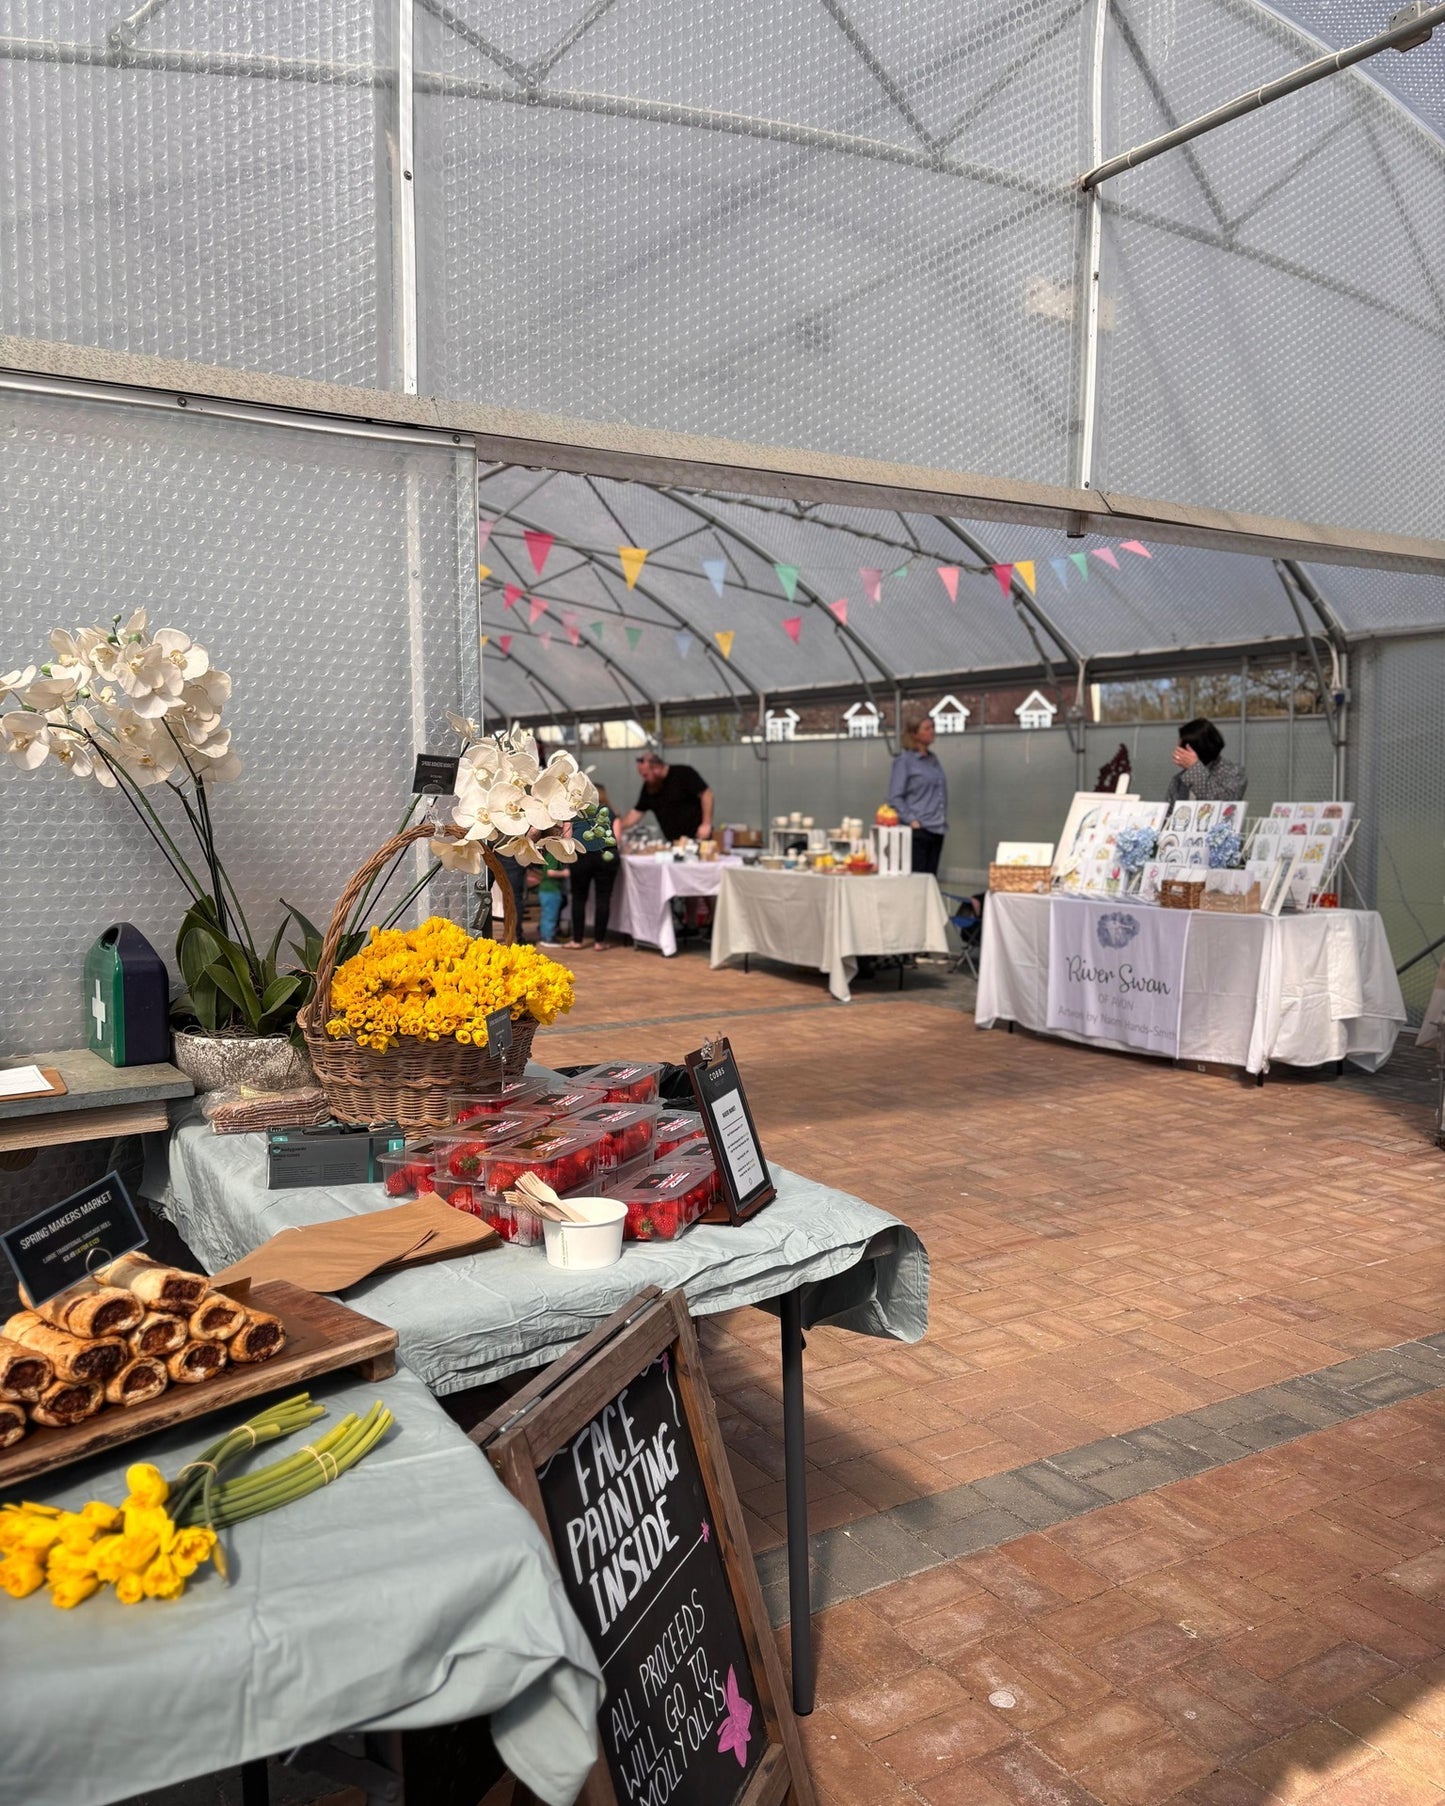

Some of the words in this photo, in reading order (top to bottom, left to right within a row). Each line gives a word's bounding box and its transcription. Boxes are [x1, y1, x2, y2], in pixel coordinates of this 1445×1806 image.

[1065, 954, 1115, 984] River
[1118, 963, 1171, 995] Swan
[1086, 1010, 1097, 1024] by
[1097, 992, 1109, 1005] OF
[393, 1141, 399, 1151] L
[20, 1226, 50, 1250] SPRING
[47, 1208, 82, 1234] MAKERS
[79, 1190, 112, 1216] MARKET
[572, 1388, 645, 1507] FACE
[566, 1422, 680, 1585] PAINTING
[589, 1494, 680, 1636] INSIDE
[611, 1688, 640, 1755] ALL
[638, 1588, 706, 1709] PROCEEDS
[619, 1725, 665, 1801] WILL
[664, 1682, 687, 1734] GO
[687, 1646, 709, 1693] TO
